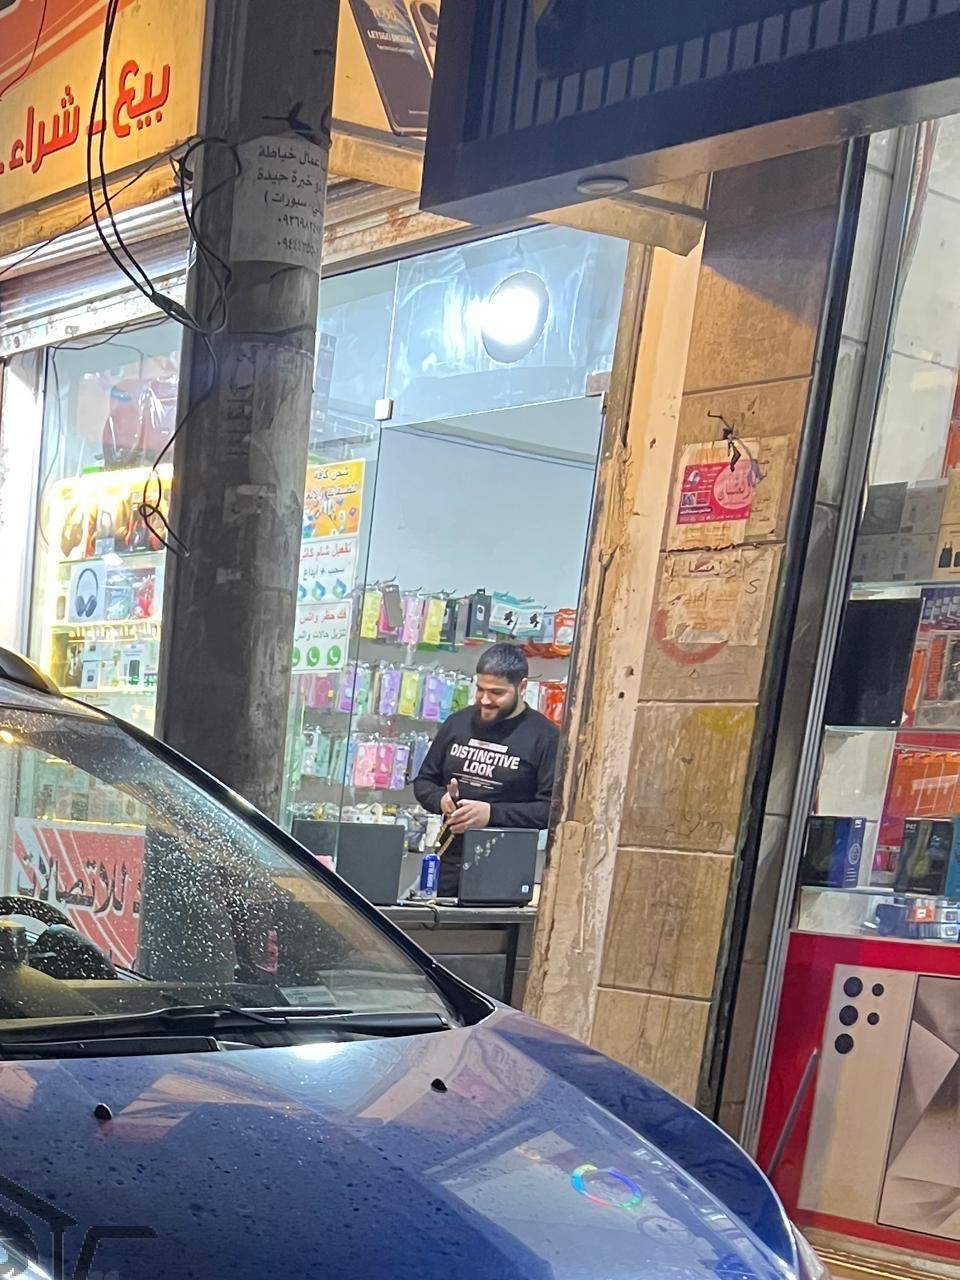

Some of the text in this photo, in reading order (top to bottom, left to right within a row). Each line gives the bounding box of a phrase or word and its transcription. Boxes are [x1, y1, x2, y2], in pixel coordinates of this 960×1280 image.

[112, 59, 171, 138] بيع
[9, 85, 81, 174] شراء
[450, 743, 520, 770] DISTINCTIVE
[462, 760, 496, 778] LOOK
